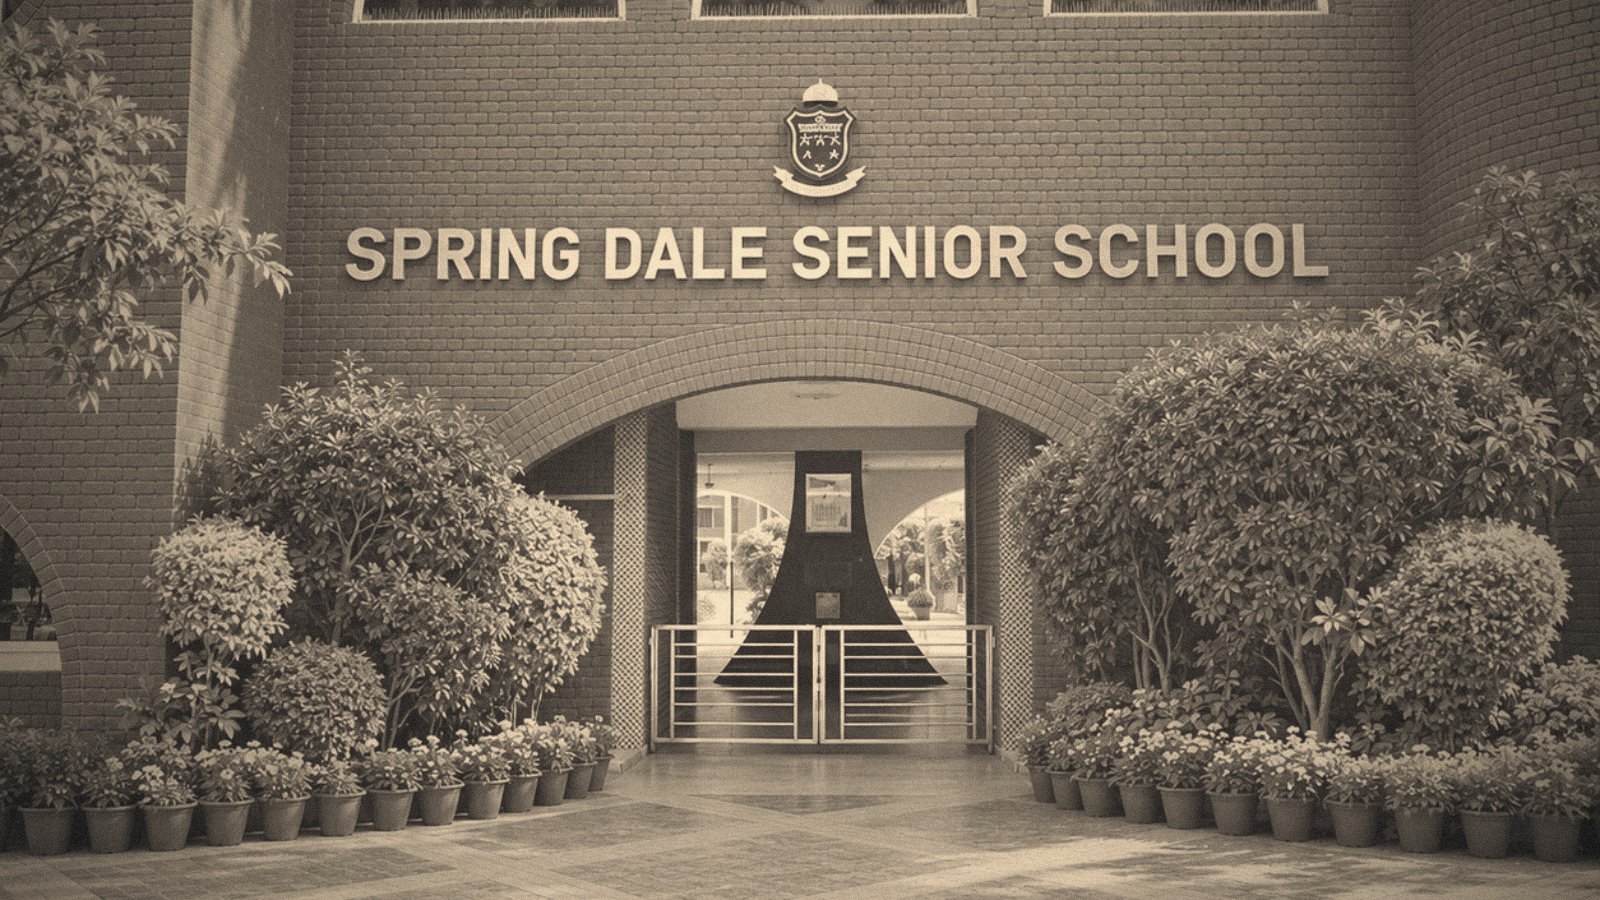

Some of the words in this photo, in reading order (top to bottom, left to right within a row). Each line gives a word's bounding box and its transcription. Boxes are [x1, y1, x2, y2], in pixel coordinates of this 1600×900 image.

[345, 226, 580, 282] SPRING
[604, 226, 768, 280] DALE
[792, 224, 1028, 280] SENIOR
[1053, 222, 1329, 279] SCHOOL
